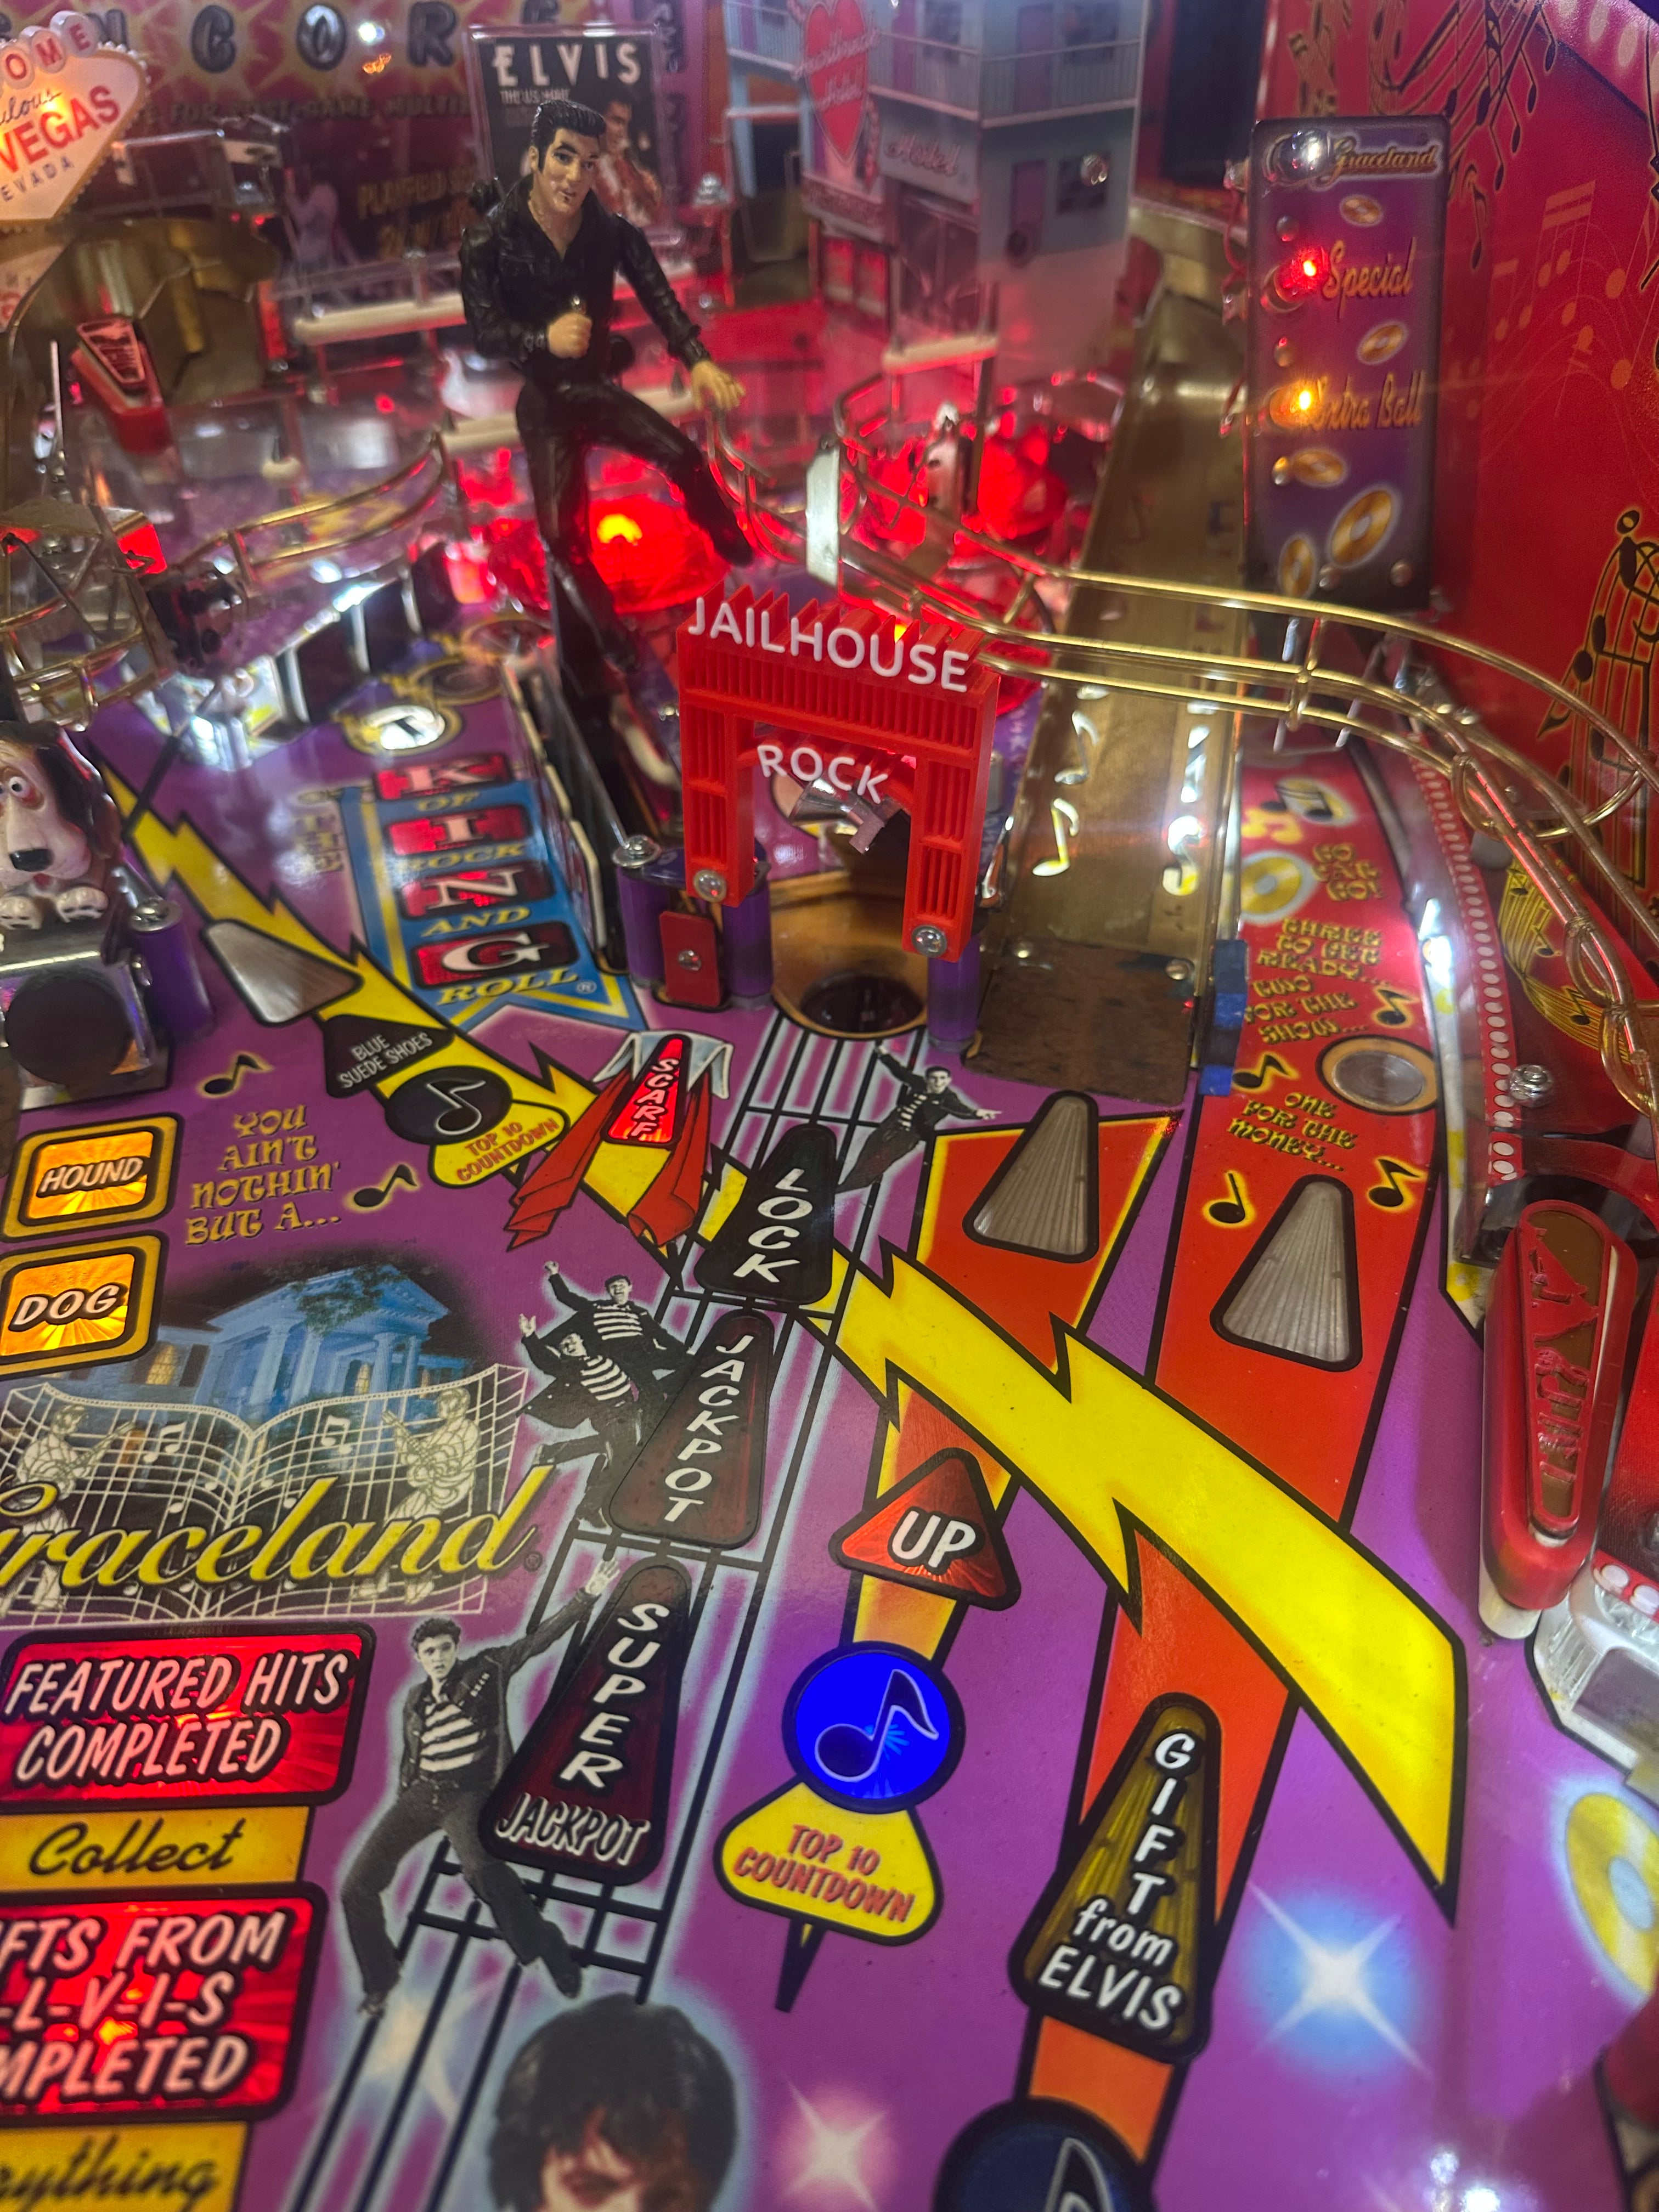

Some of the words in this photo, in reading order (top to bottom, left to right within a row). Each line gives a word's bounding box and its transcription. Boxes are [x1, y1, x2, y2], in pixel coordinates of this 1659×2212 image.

[494, 43, 641, 86] ELVIS
[0, 85, 120, 173] VEGAS
[1322, 236, 1418, 319] Special
[1376, 369, 1426, 428] Ball
[688, 597, 969, 692] JAILHOUSE
[757, 744, 888, 804] ROCK
[421, 907, 531, 937] AND
[437, 967, 579, 1006] ROLL
[1252, 974, 1314, 998] TWO
[1299, 992, 1358, 1015] THE
[337, 1058, 387, 1090] SUEDE
[386, 1031, 433, 1065] SHOES
[351, 1033, 388, 1061] BLUE
[233, 1103, 309, 1138] YOU
[629, 1058, 680, 1138] SCARF
[1243, 1099, 1299, 1130] FOR
[1302, 1119, 1359, 1150] THE
[1284, 1092, 1338, 1120] ONE
[217, 1134, 319, 1172] AIN'T
[456, 1117, 561, 1182] COUNTDOWN
[465, 1130, 498, 1154] TOP
[501, 1121, 524, 1141] 10
[39, 1158, 144, 1194] HOUND
[190, 1160, 342, 1211] NOTHIN'
[184, 1207, 264, 1246] BUT
[733, 1168, 814, 1283] LOCK
[14, 1285, 120, 1325] DOG
[664, 1335, 755, 1522] JACKPOT
[890, 1510, 977, 1570] UP
[5, 1656, 233, 1716] FEATURED
[244, 1652, 348, 1707] HITS
[559, 1602, 670, 1788] SUPER
[15, 1719, 283, 1782] COMPLETED
[29, 1817, 247, 1877] Collect
[495, 1792, 652, 1866] JACKPOT
[788, 1824, 843, 1863] TOP
[850, 1842, 881, 1876] 10
[1126, 1732, 1195, 1915] GIFT
[732, 1846, 916, 1923] COUNTDOWN
[116, 1912, 287, 1968] FROM
[1073, 1898, 1176, 1967] from
[1039, 1944, 1183, 2031] ELVIS
